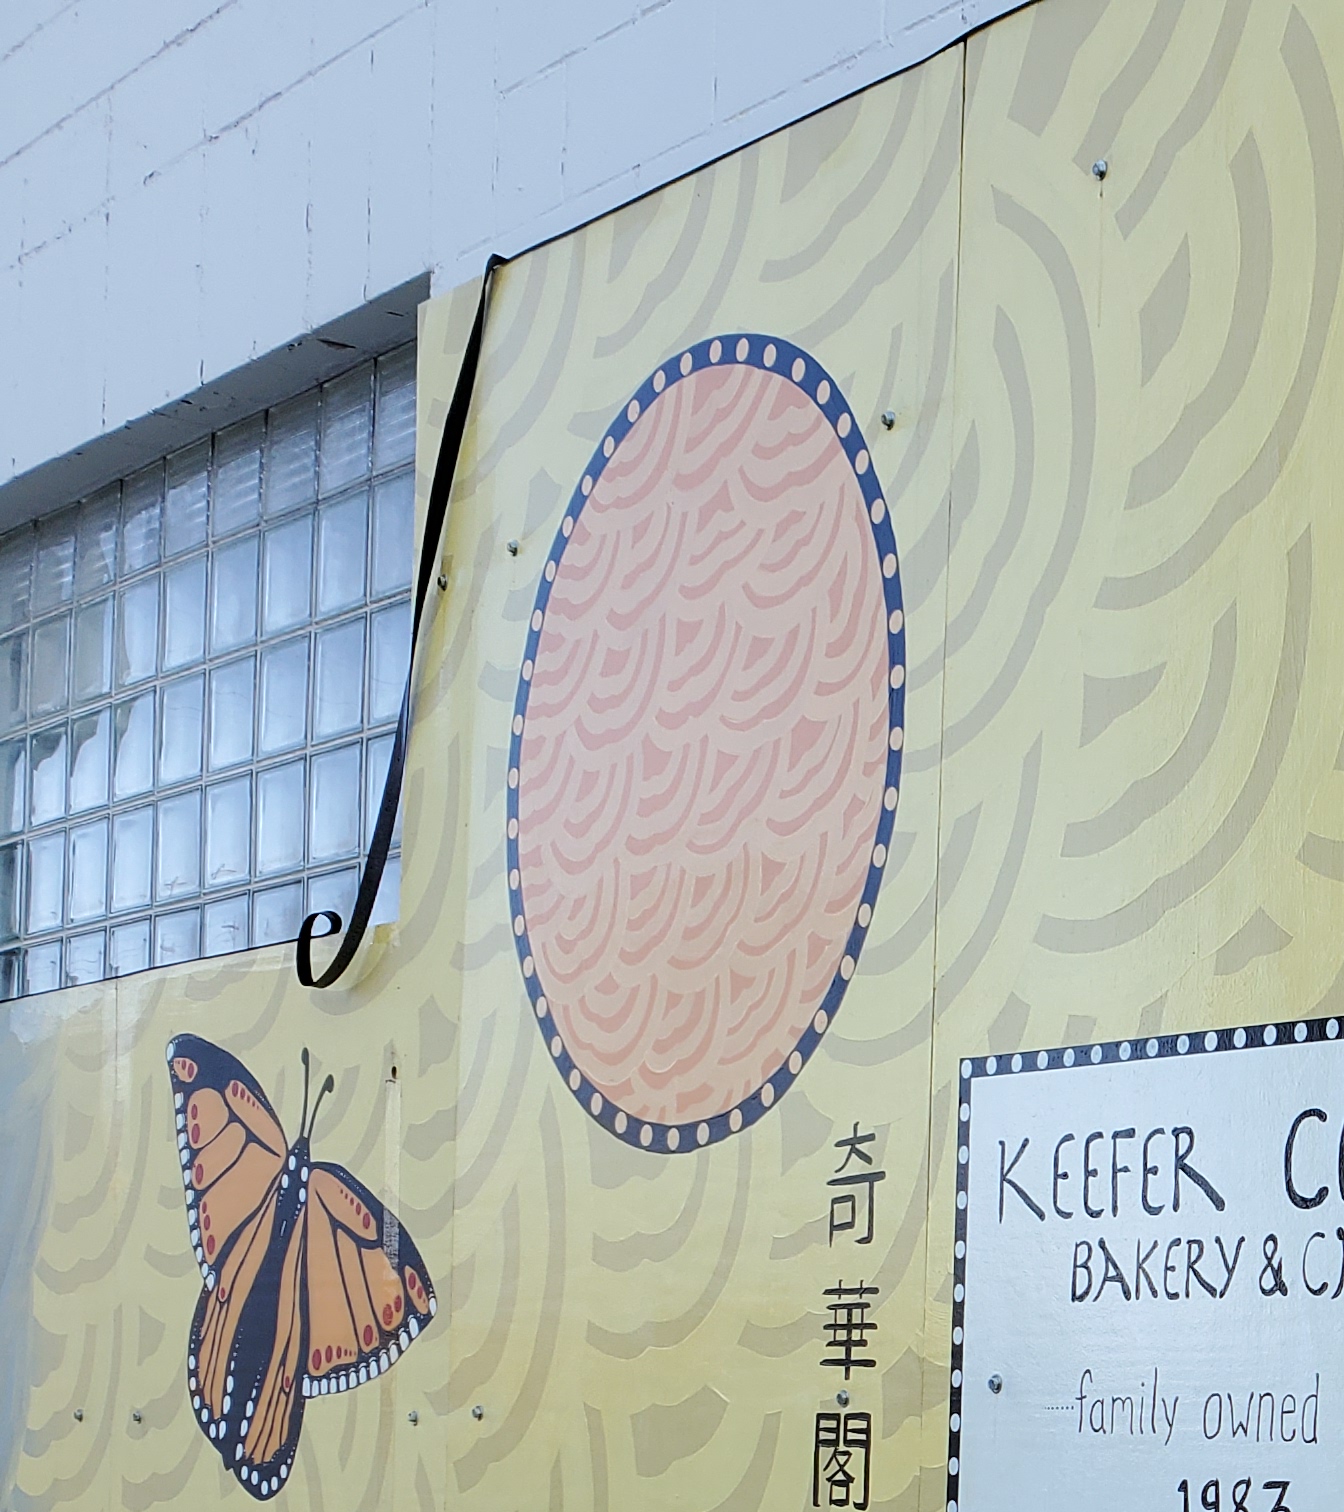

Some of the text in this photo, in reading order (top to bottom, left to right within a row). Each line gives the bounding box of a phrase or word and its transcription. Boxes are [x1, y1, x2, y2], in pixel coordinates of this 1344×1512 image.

[998, 1126, 1225, 1224] KEEFER
[1070, 1234, 1245, 1303] BAKERY
[1258, 1232, 1289, 1299] &
[1074, 1367, 1180, 1447] family
[1202, 1372, 1320, 1446] owned
